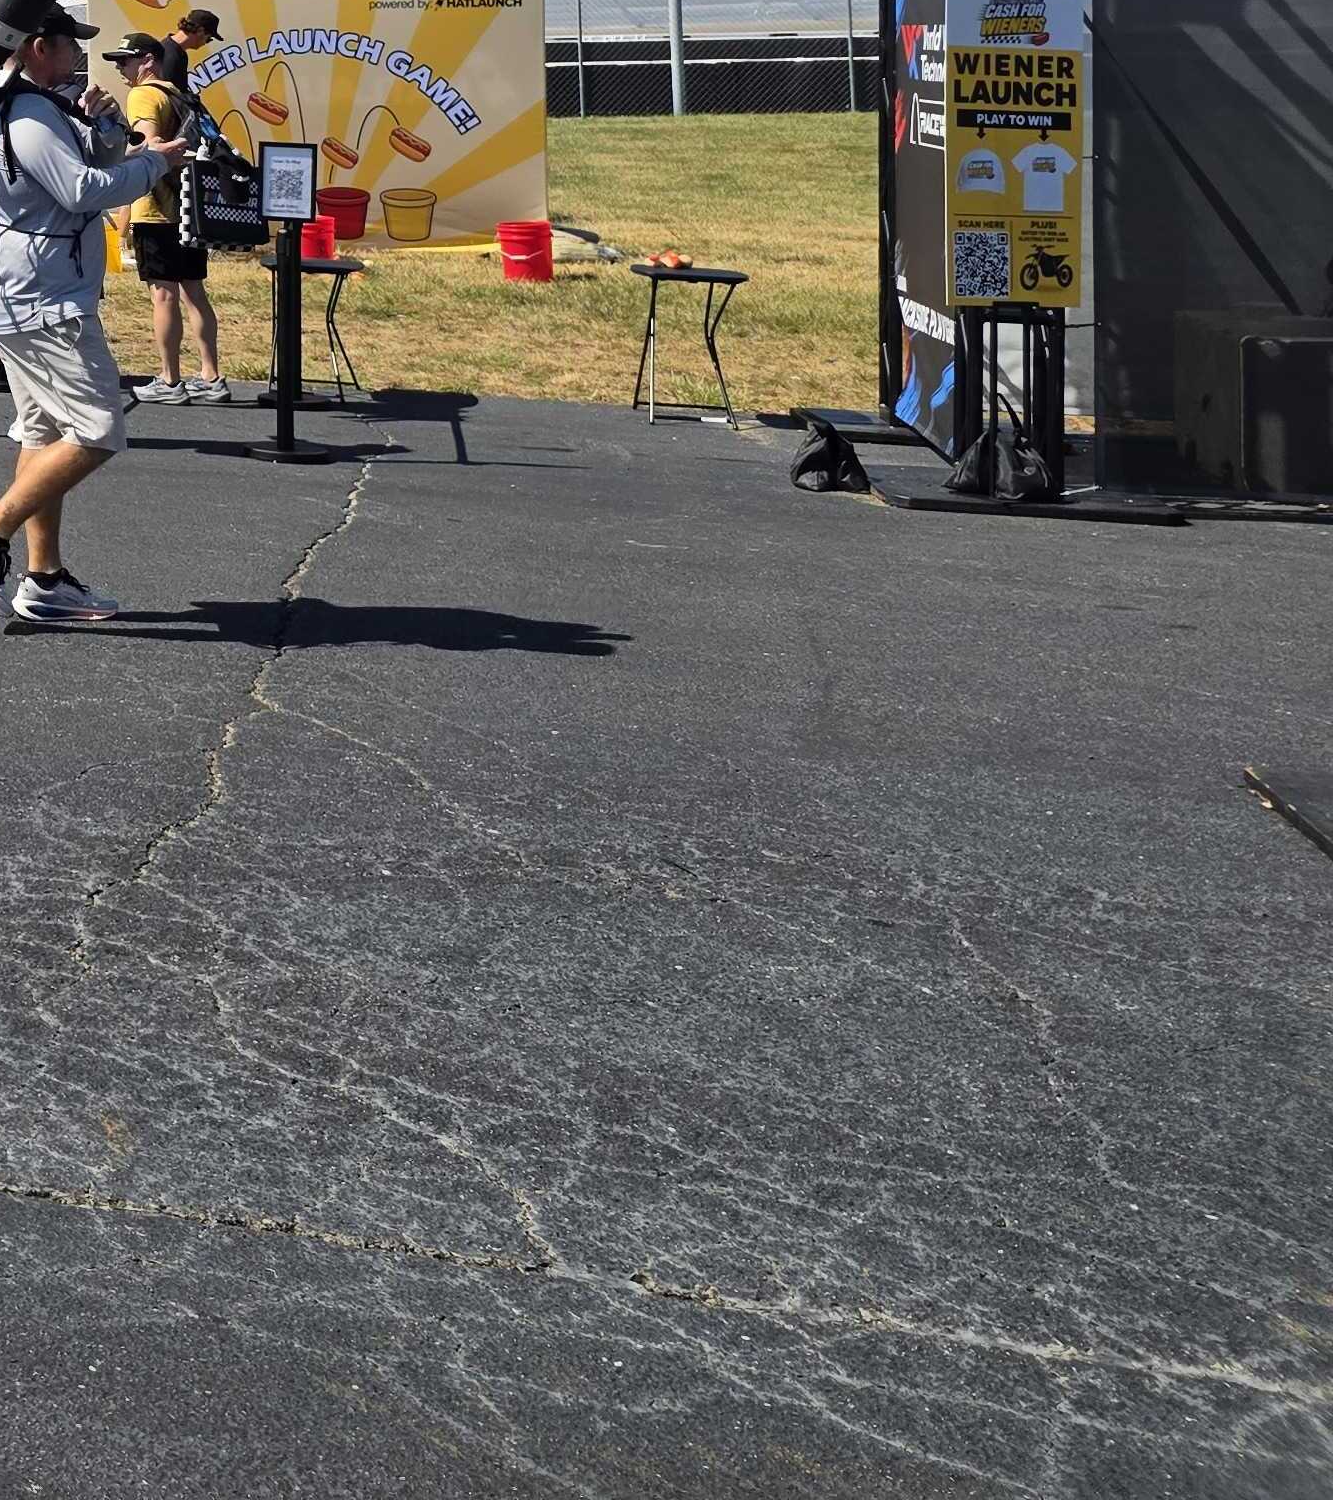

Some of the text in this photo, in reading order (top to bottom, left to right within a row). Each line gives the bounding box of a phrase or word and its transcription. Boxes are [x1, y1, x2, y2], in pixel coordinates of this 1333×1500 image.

[985, 3, 1045, 18] CASH FOR
[981, 17, 1046, 35] WIENERS
[953, 52, 1075, 79] WIENER
[246, 29, 384, 65] LAUNCH
[386, 50, 482, 135] GAME!
[954, 79, 1077, 107] LAUNCH
[976, 113, 1052, 127] PLAY TO WIN
[957, 220, 1006, 229] SCAN HERE
